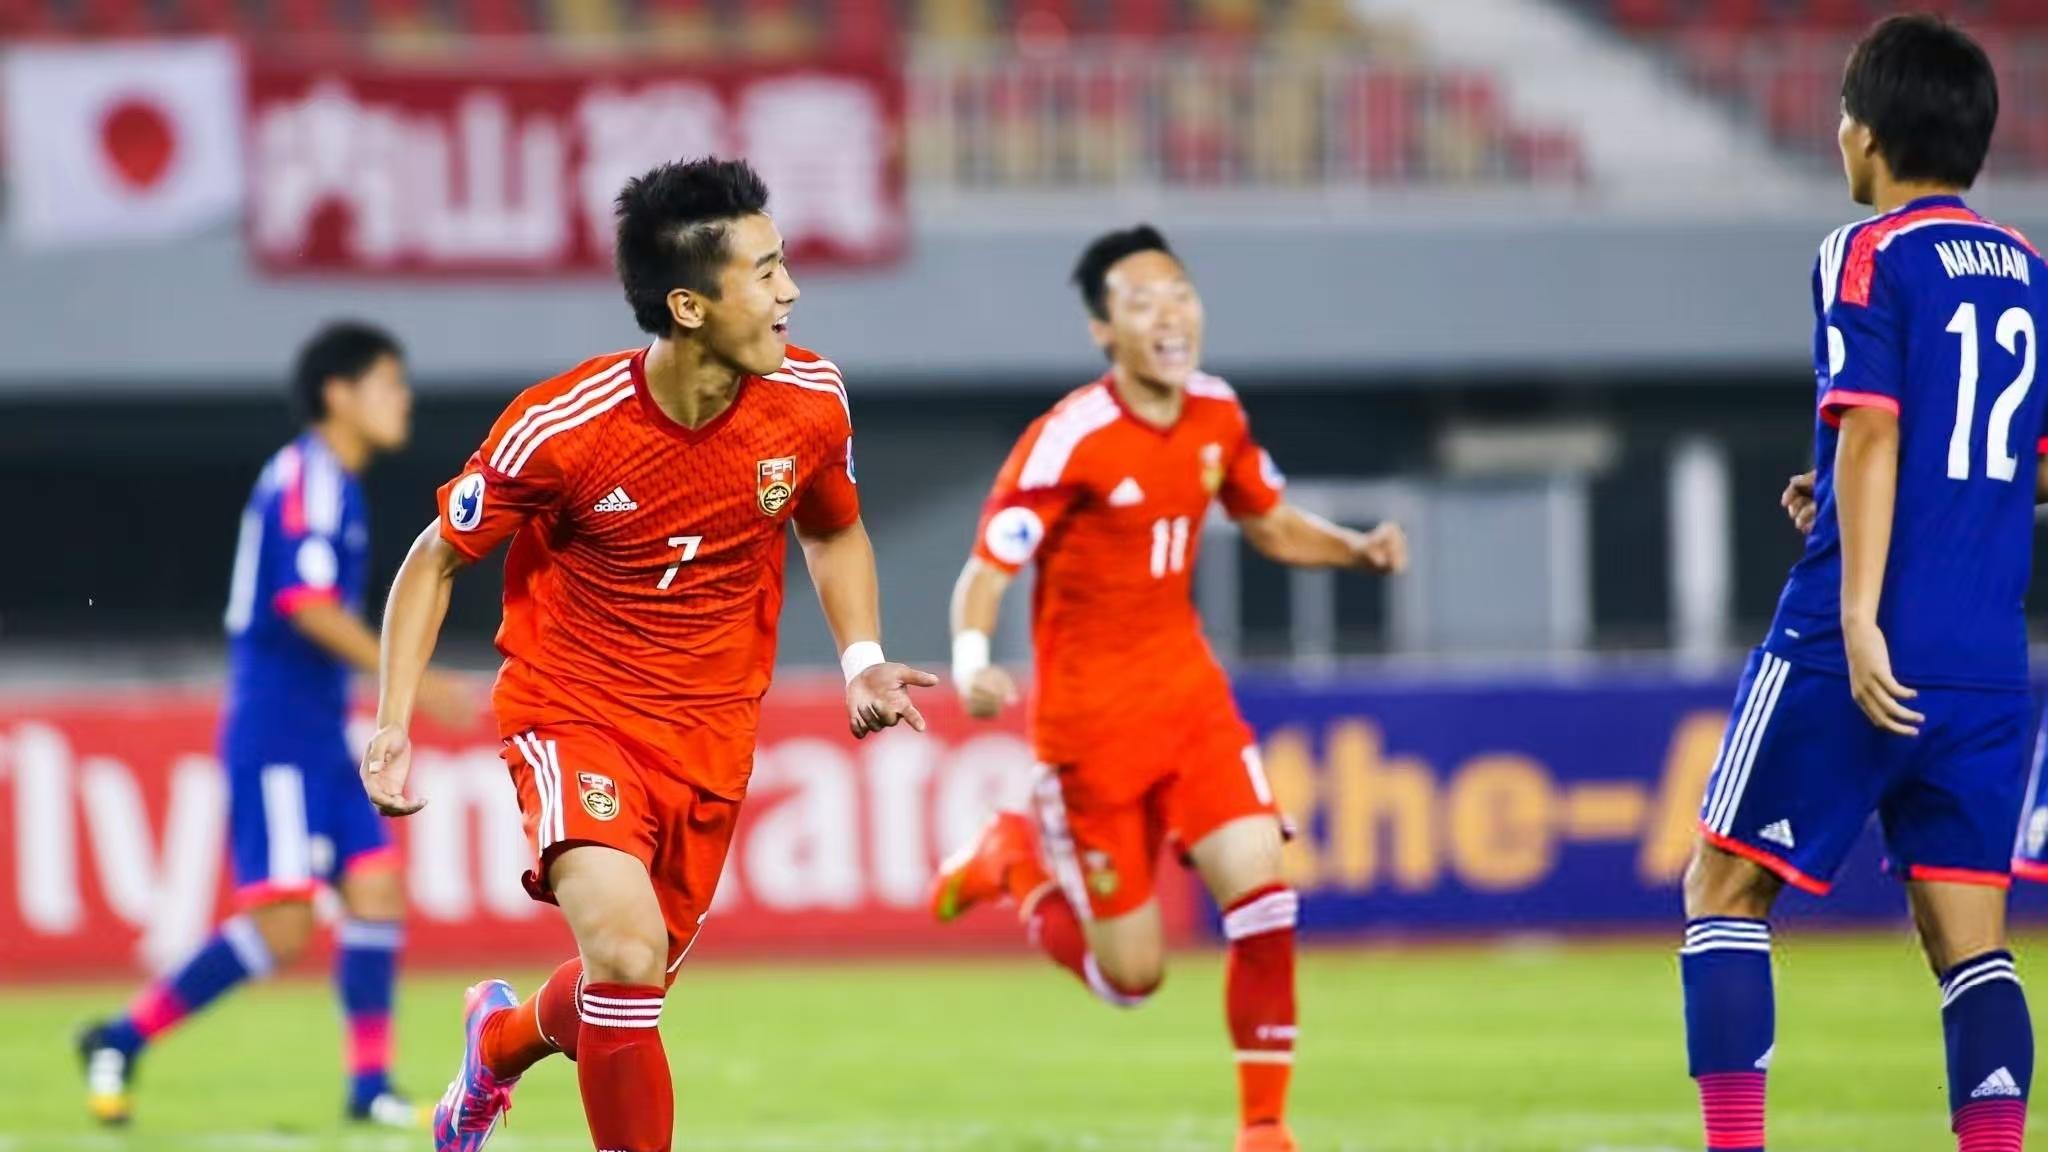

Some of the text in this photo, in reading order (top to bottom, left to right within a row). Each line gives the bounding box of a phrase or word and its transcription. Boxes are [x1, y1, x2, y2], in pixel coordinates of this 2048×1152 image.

[256, 78, 880, 251] 内山
[1945, 301, 2036, 483] 12
[593, 501, 638, 513] adidas
[657, 536, 703, 590] 7
[1150, 516, 1190, 578] 11
[0, 720, 234, 974] ly
